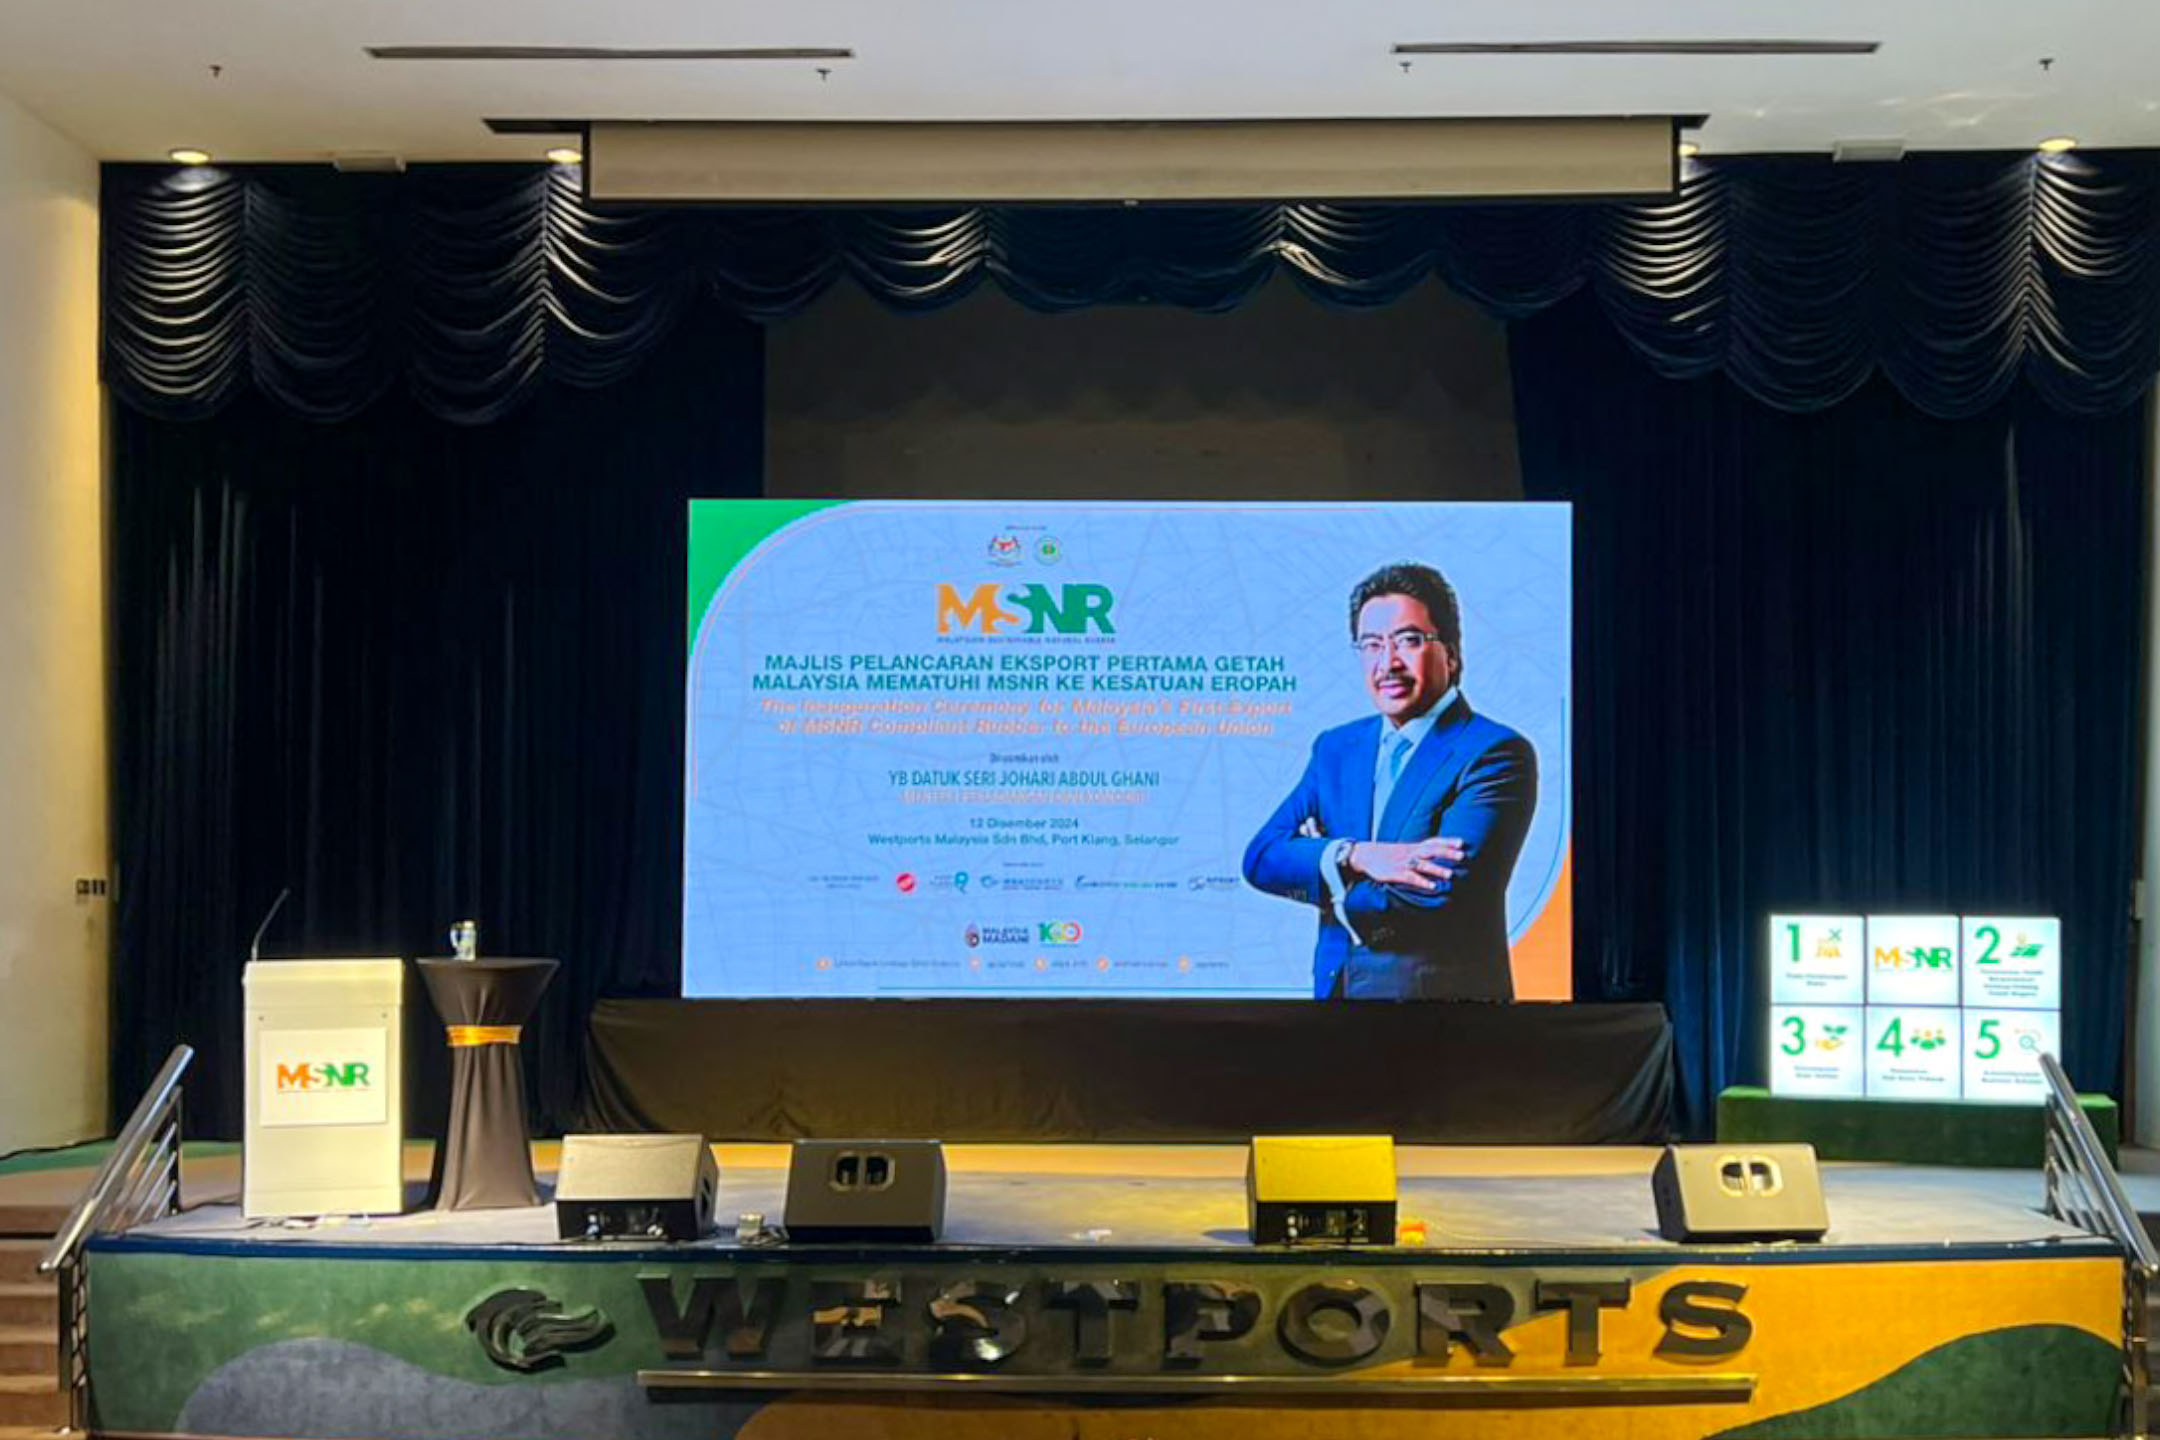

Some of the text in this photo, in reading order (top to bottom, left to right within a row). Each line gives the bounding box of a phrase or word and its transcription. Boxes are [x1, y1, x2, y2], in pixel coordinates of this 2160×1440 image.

[935, 583, 1116, 633] MSNR
[765, 655, 1285, 672] MAJLIS PELANCARAN EKSPORT PERTAMA GETAH
[753, 674, 1297, 691] MALAYSIA MEMATUHI MSNR KE KESATUAN EROPAH
[761, 698, 796, 713] The
[802, 719, 863, 734] MSNR
[888, 770, 1160, 787] YB DATUK SERI JOHARI ABDUL GHANI
[987, 818, 1046, 829] Disember
[1050, 818, 1079, 829] 2024
[868, 833, 931, 847] Westports
[935, 833, 989, 847] Malaysia
[992, 833, 1017, 845] Sdn
[1052, 834, 1078, 845] Port
[1124, 834, 1179, 847] Selangor
[982, 934, 1029, 944] MADANI
[1786, 923, 1800, 963] 1
[1975, 925, 2001, 964] 2
[1781, 1016, 1806, 1056] 3
[1876, 1017, 1905, 1058] 4
[1975, 1019, 2001, 1060] 5
[277, 1062, 371, 1089] MSNR
[636, 1273, 1754, 1368] WESTPORTS
